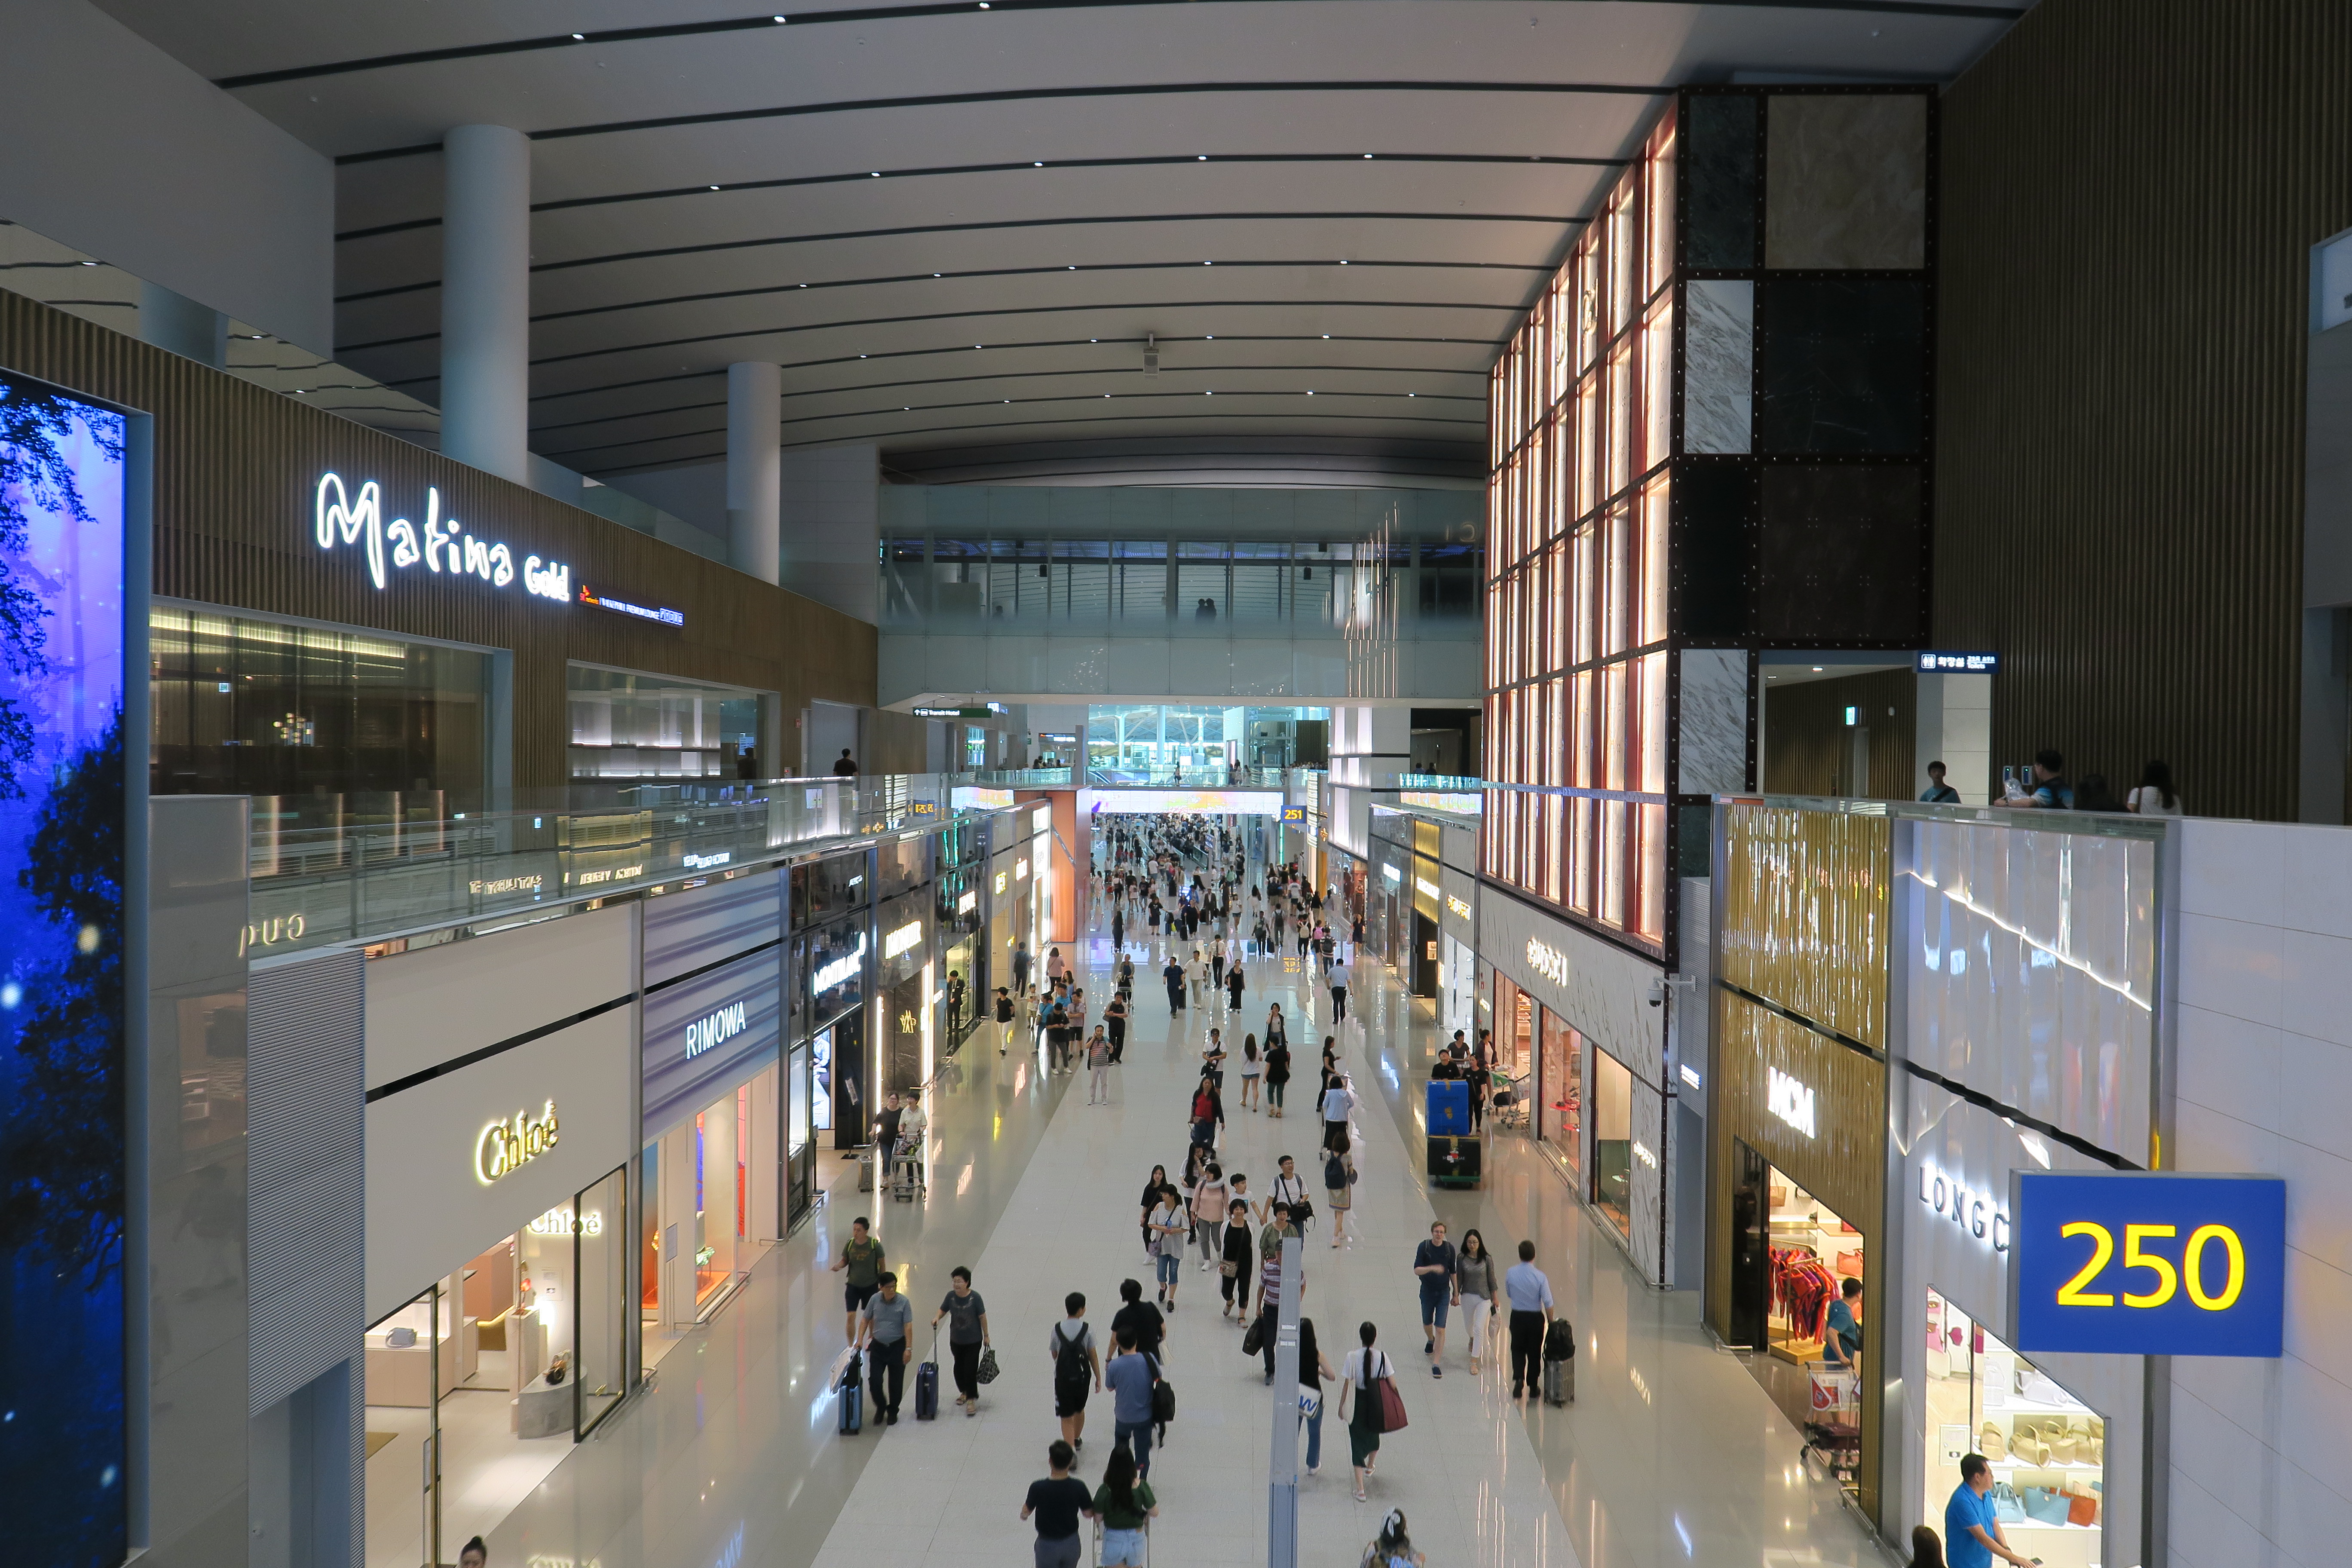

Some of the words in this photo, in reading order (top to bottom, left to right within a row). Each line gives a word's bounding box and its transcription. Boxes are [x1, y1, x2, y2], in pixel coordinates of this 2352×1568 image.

[317, 472, 514, 589] Matina
[524, 554, 570, 602] Gold
[1938, 656, 1965, 667] 화장실
[1284, 809, 1302, 820] 251
[1526, 937, 1568, 988] GUCCI
[686, 1000, 747, 1060] RIMOWA
[1767, 1065, 1816, 1139] MCM
[476, 1100, 559, 1182] Chloé
[529, 1212, 600, 1234] Chloé
[2056, 1220, 2246, 1311] 250
